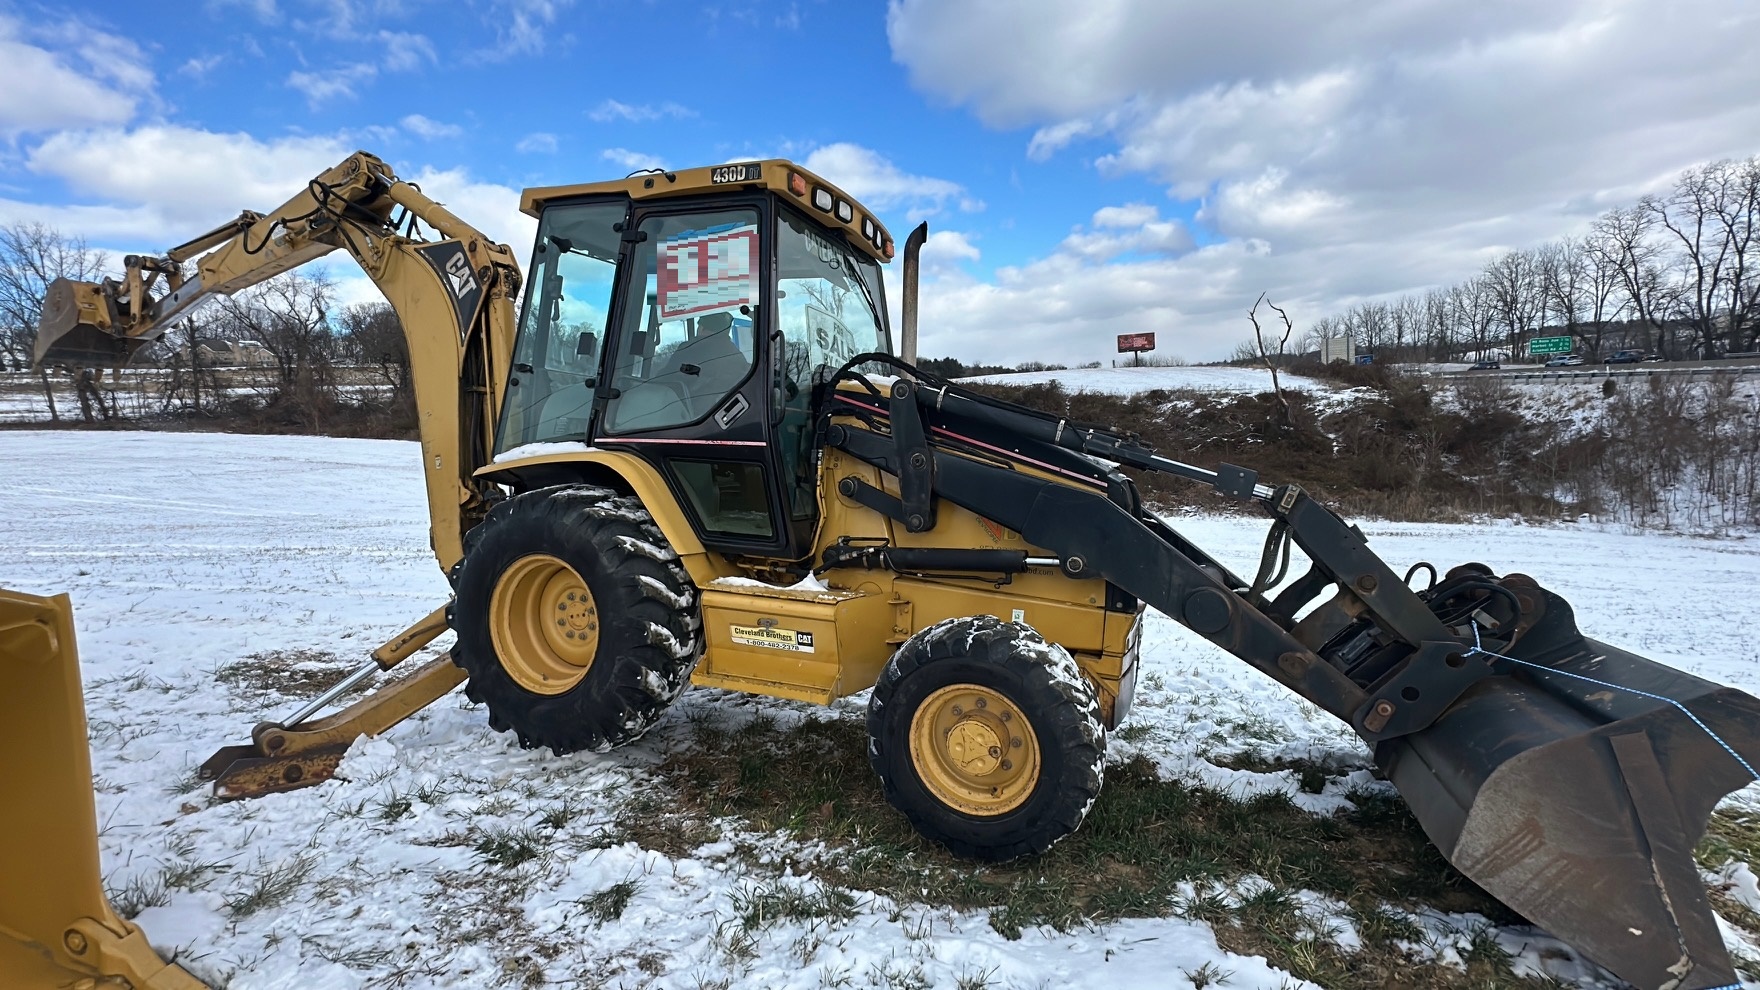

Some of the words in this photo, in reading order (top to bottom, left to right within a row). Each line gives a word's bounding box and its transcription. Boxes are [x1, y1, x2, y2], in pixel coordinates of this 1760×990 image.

[713, 166, 746, 183] 430D
[446, 251, 477, 300] CAT
[734, 627, 765, 637] Cleveland
[765, 631, 793, 642] Brothers
[797, 634, 812, 644] CAT
